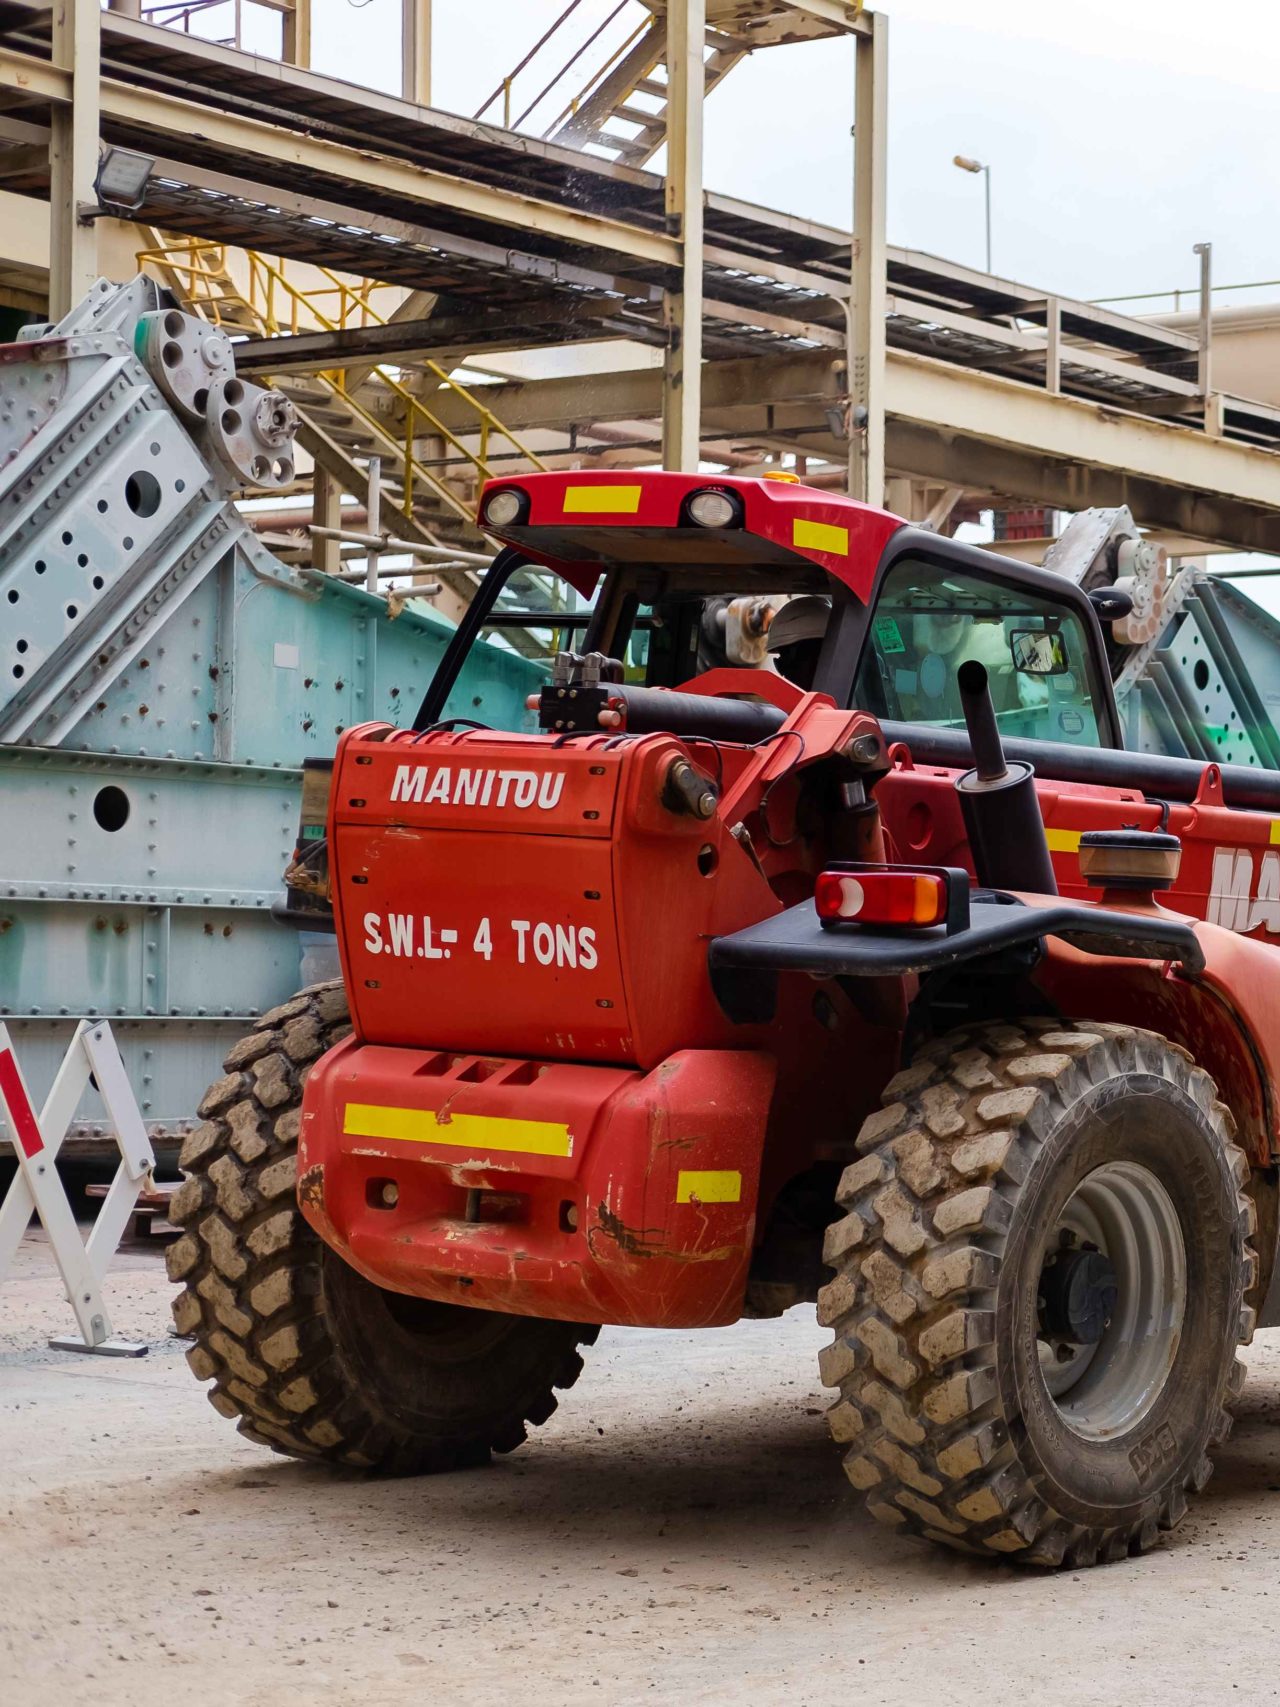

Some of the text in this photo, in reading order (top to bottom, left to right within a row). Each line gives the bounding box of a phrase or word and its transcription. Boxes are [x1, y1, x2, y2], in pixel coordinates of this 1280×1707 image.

[390, 765, 567, 810] MANITOU
[473, 917, 493, 961] 4
[511, 920, 598, 970] TONS
